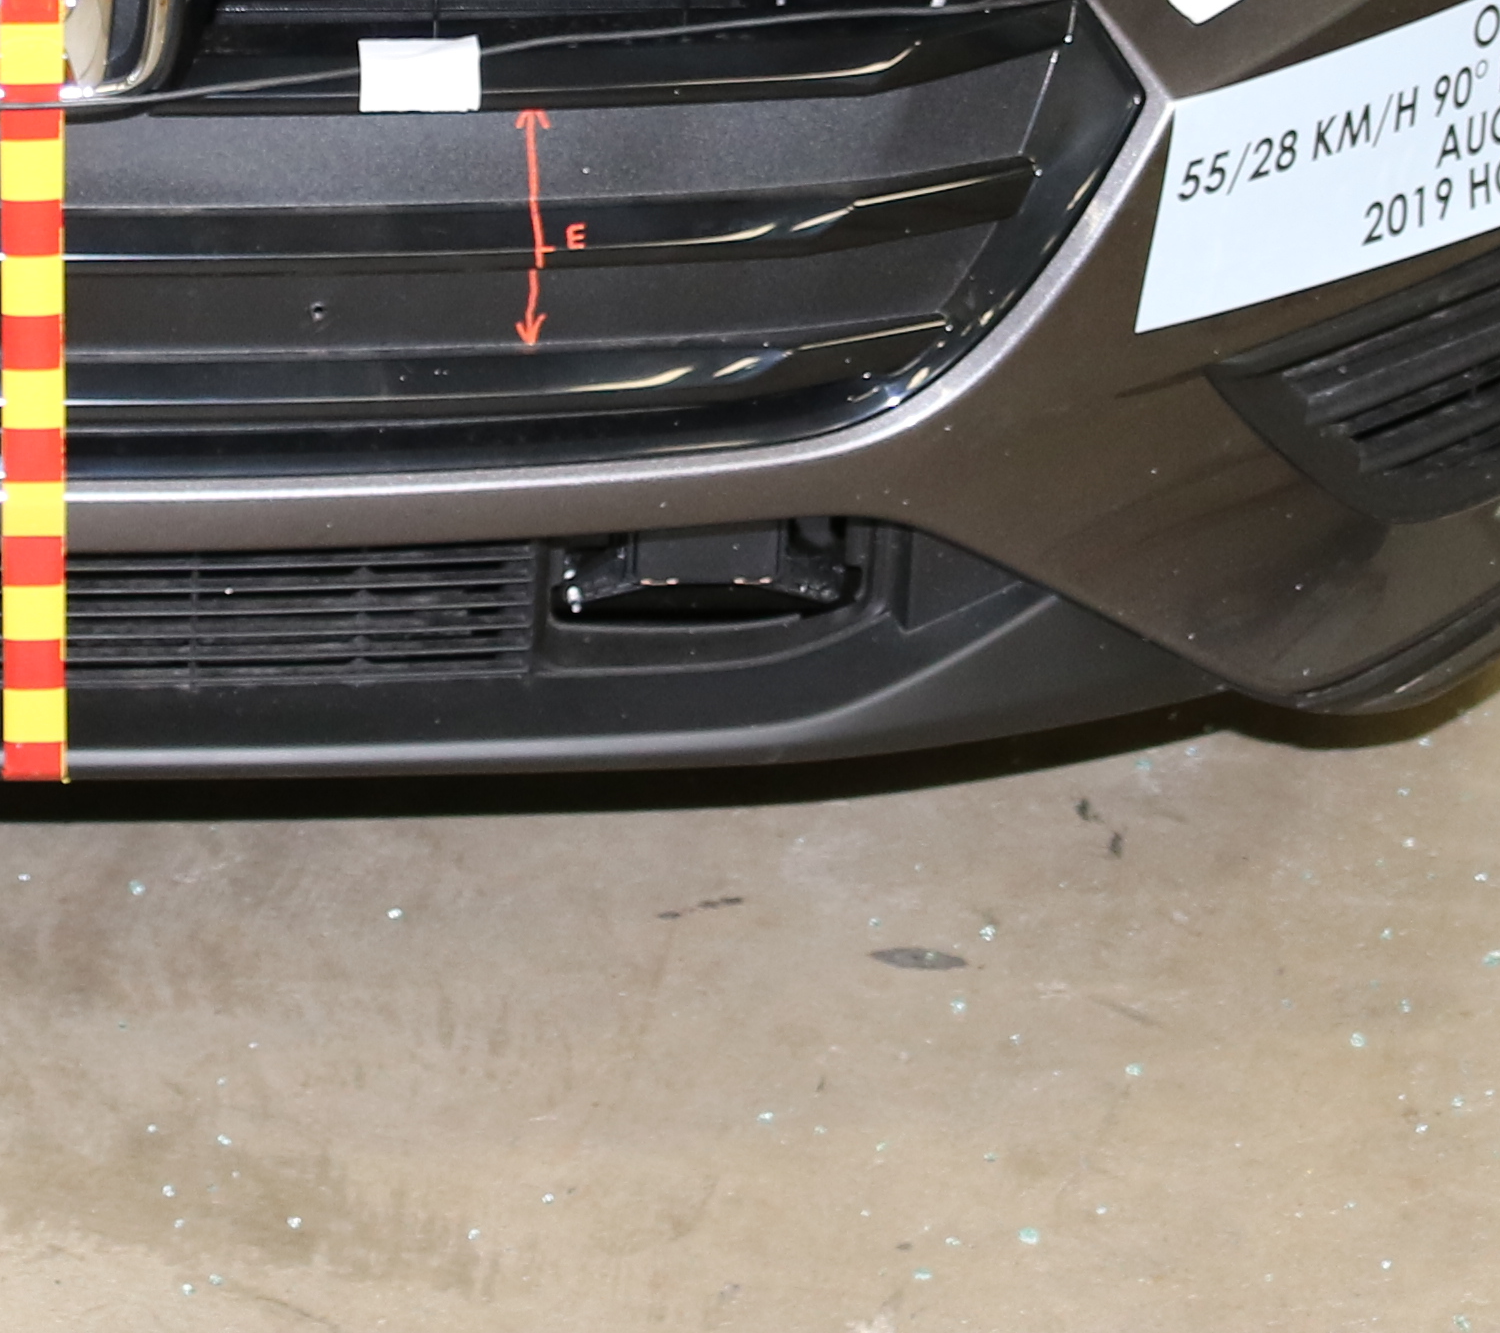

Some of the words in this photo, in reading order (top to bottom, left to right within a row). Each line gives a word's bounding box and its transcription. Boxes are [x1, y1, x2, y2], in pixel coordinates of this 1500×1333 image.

[1177, 130, 1298, 203] 55/28
[1312, 85, 1419, 162] KM/H
[1433, 59, 1489, 118] 90°
[565, 222, 588, 250] E
[1362, 177, 1453, 246] 2019
